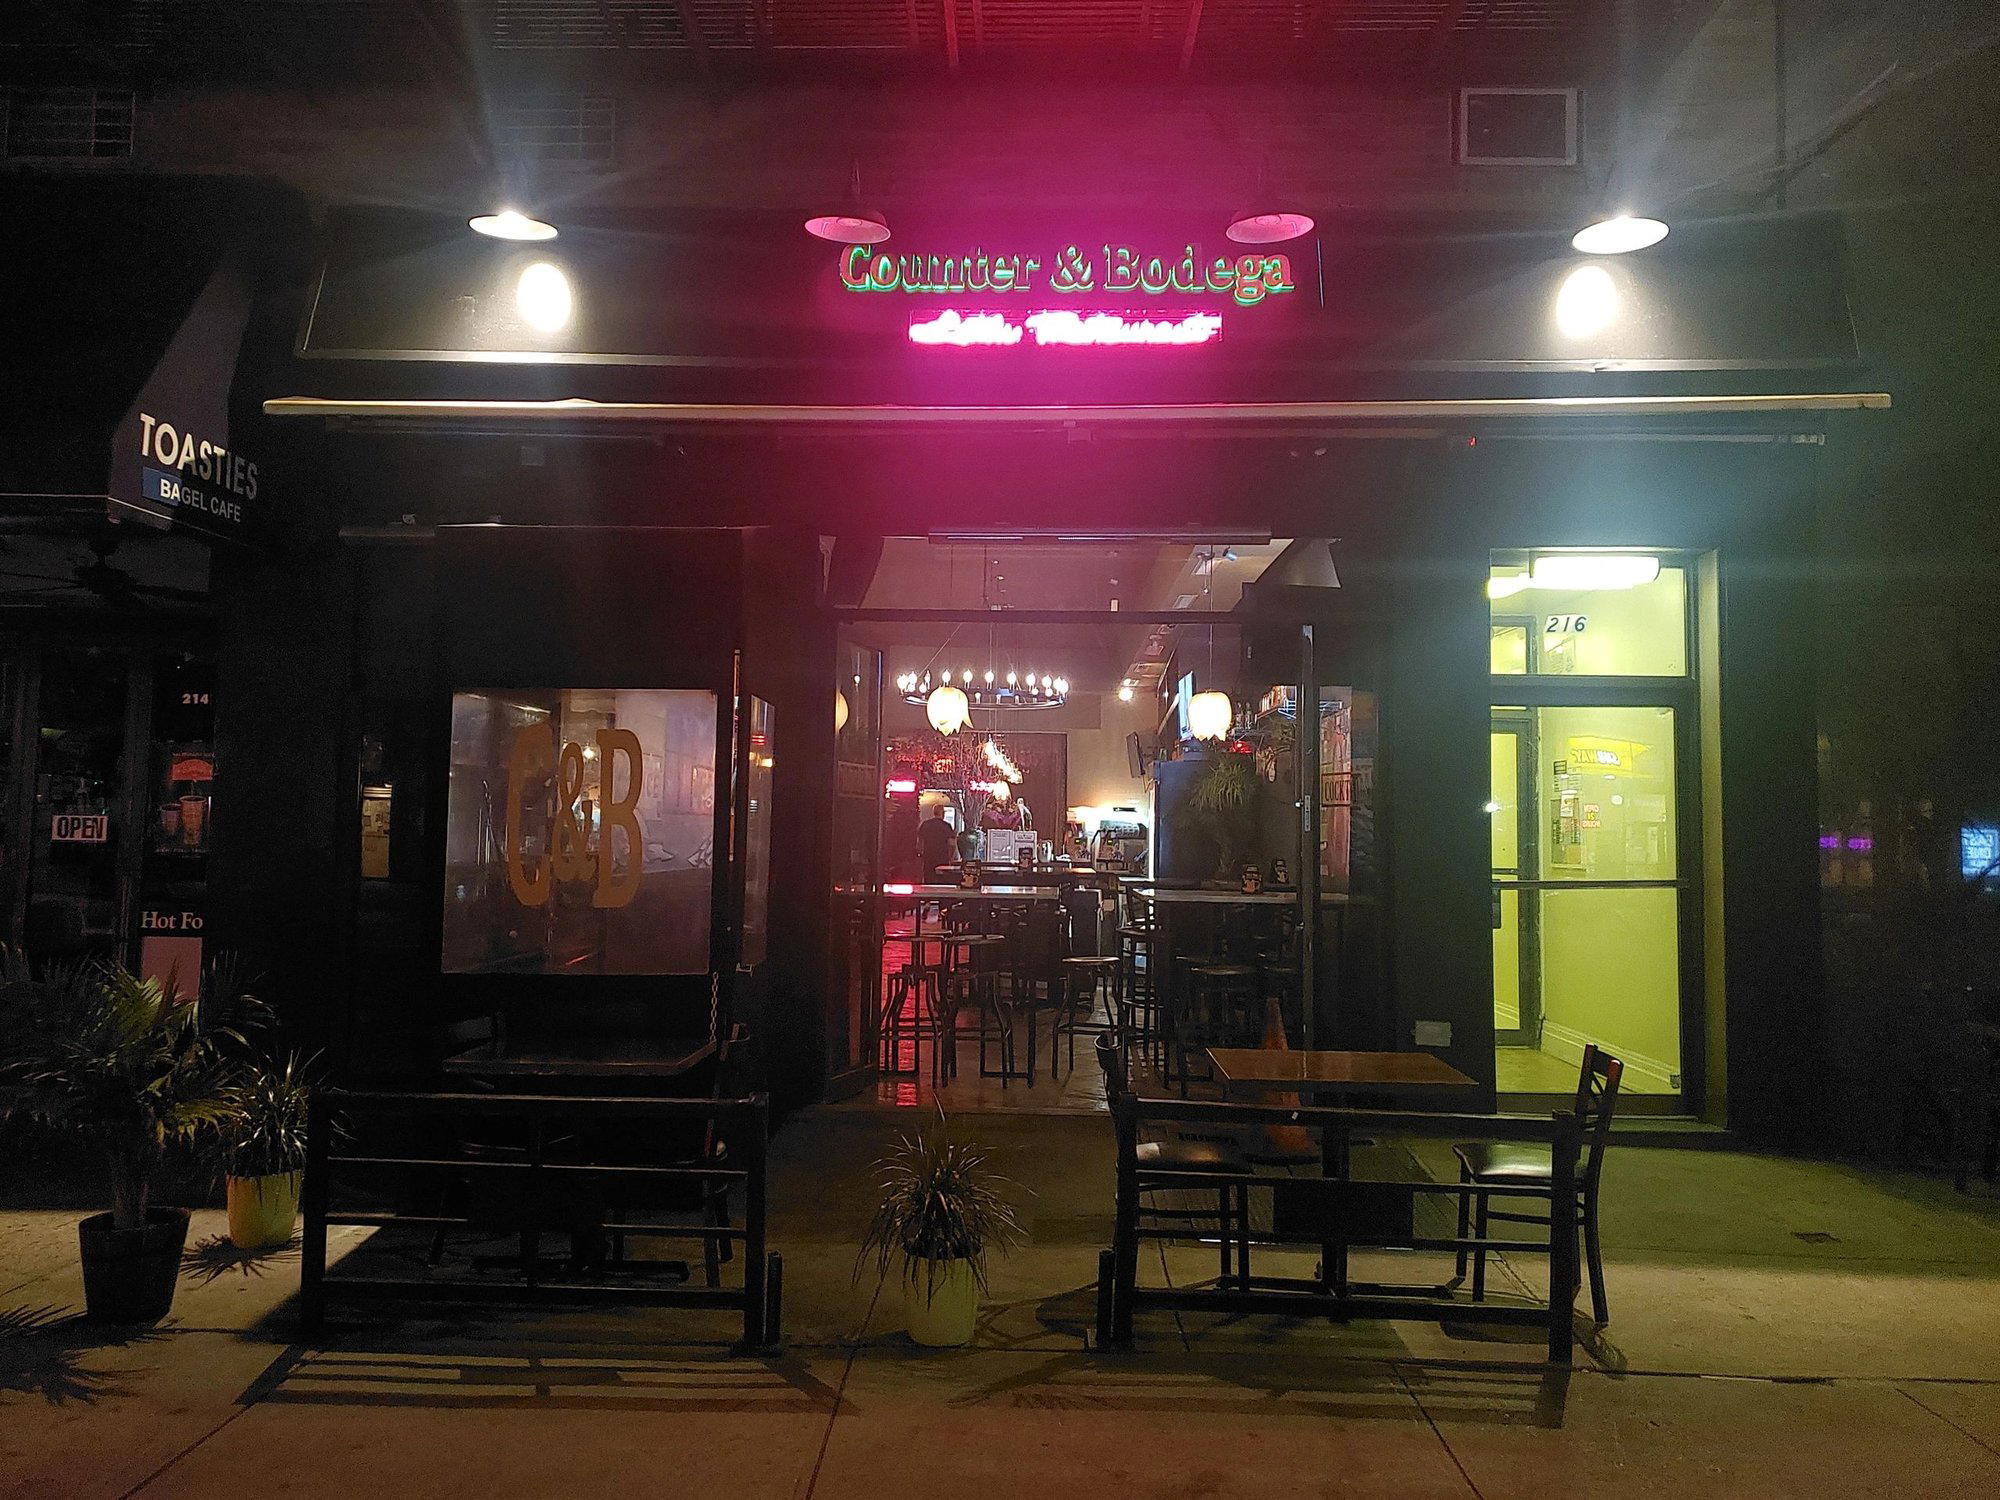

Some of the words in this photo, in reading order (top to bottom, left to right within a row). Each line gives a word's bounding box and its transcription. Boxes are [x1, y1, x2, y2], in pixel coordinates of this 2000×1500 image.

[839, 243, 1041, 293] Counter
[1049, 245, 1093, 293] &
[1103, 243, 1295, 305] Bodega
[139, 412, 259, 500] TOASTIES
[160, 478, 208, 511] BAGEL
[210, 496, 241, 523] CAFE
[1546, 615, 1587, 633] 216
[181, 692, 210, 705] 214
[56, 816, 105, 841] OPEN
[141, 911, 178, 929] Hot
[180, 911, 204, 929] Fo
